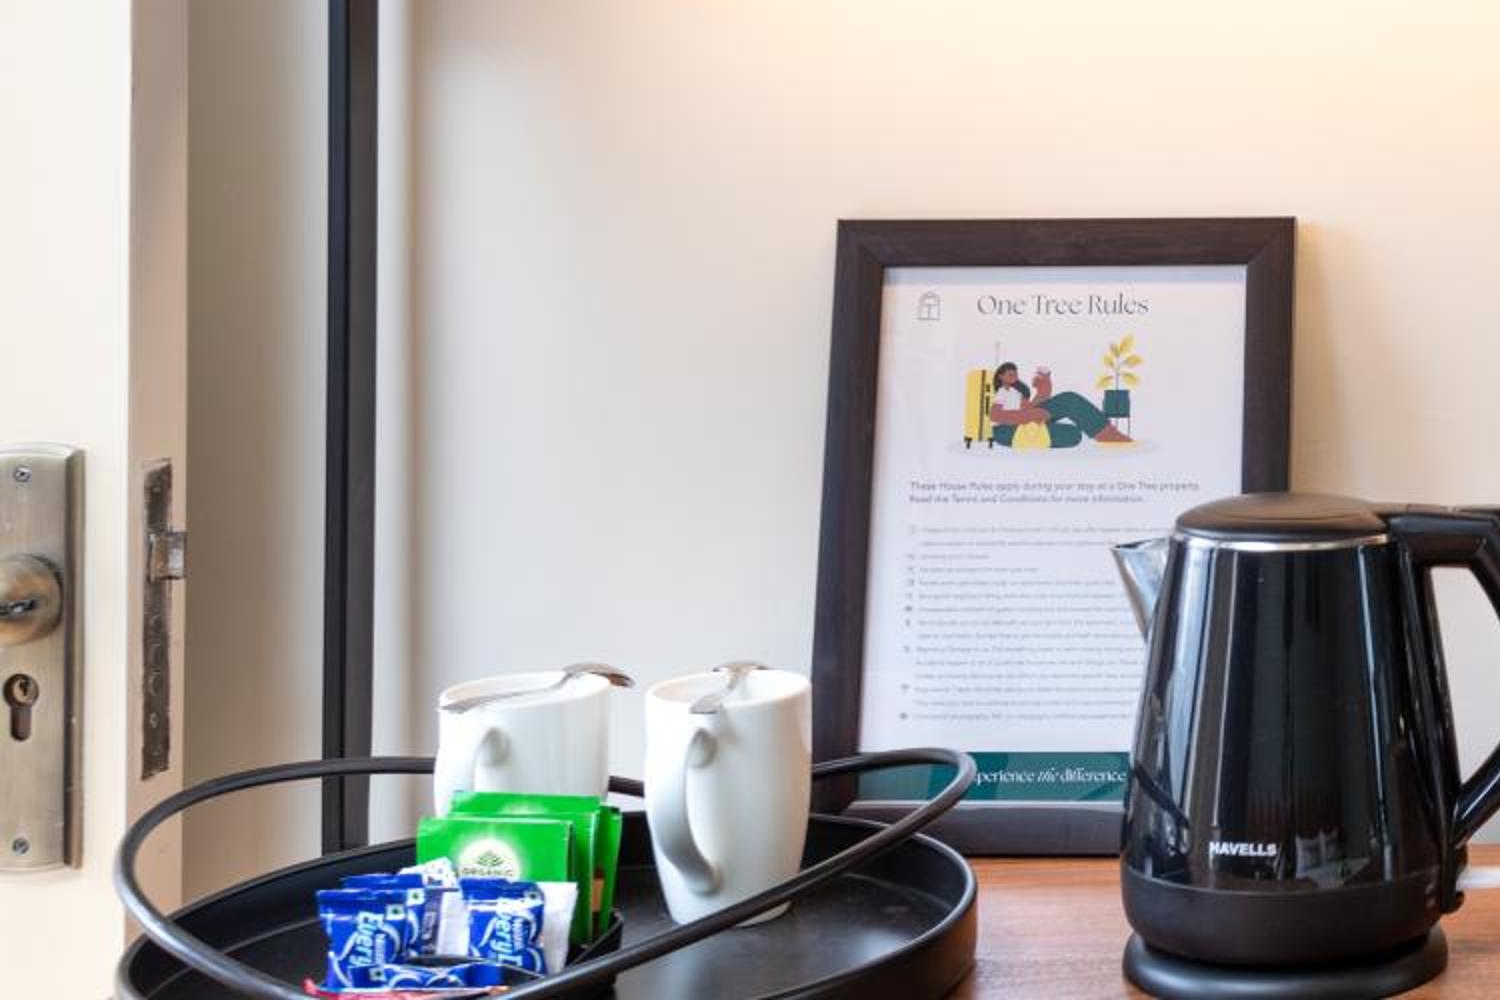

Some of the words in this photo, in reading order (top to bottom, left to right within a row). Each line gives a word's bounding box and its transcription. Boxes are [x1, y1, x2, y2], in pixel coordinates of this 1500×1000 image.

[976, 295, 1027, 315] One
[1032, 294, 1083, 315] Tree
[1088, 292, 1149, 315] Rules
[976, 769, 1035, 786] perience
[1060, 767, 1128, 783] difference
[1209, 841, 1278, 857] HAVELLS
